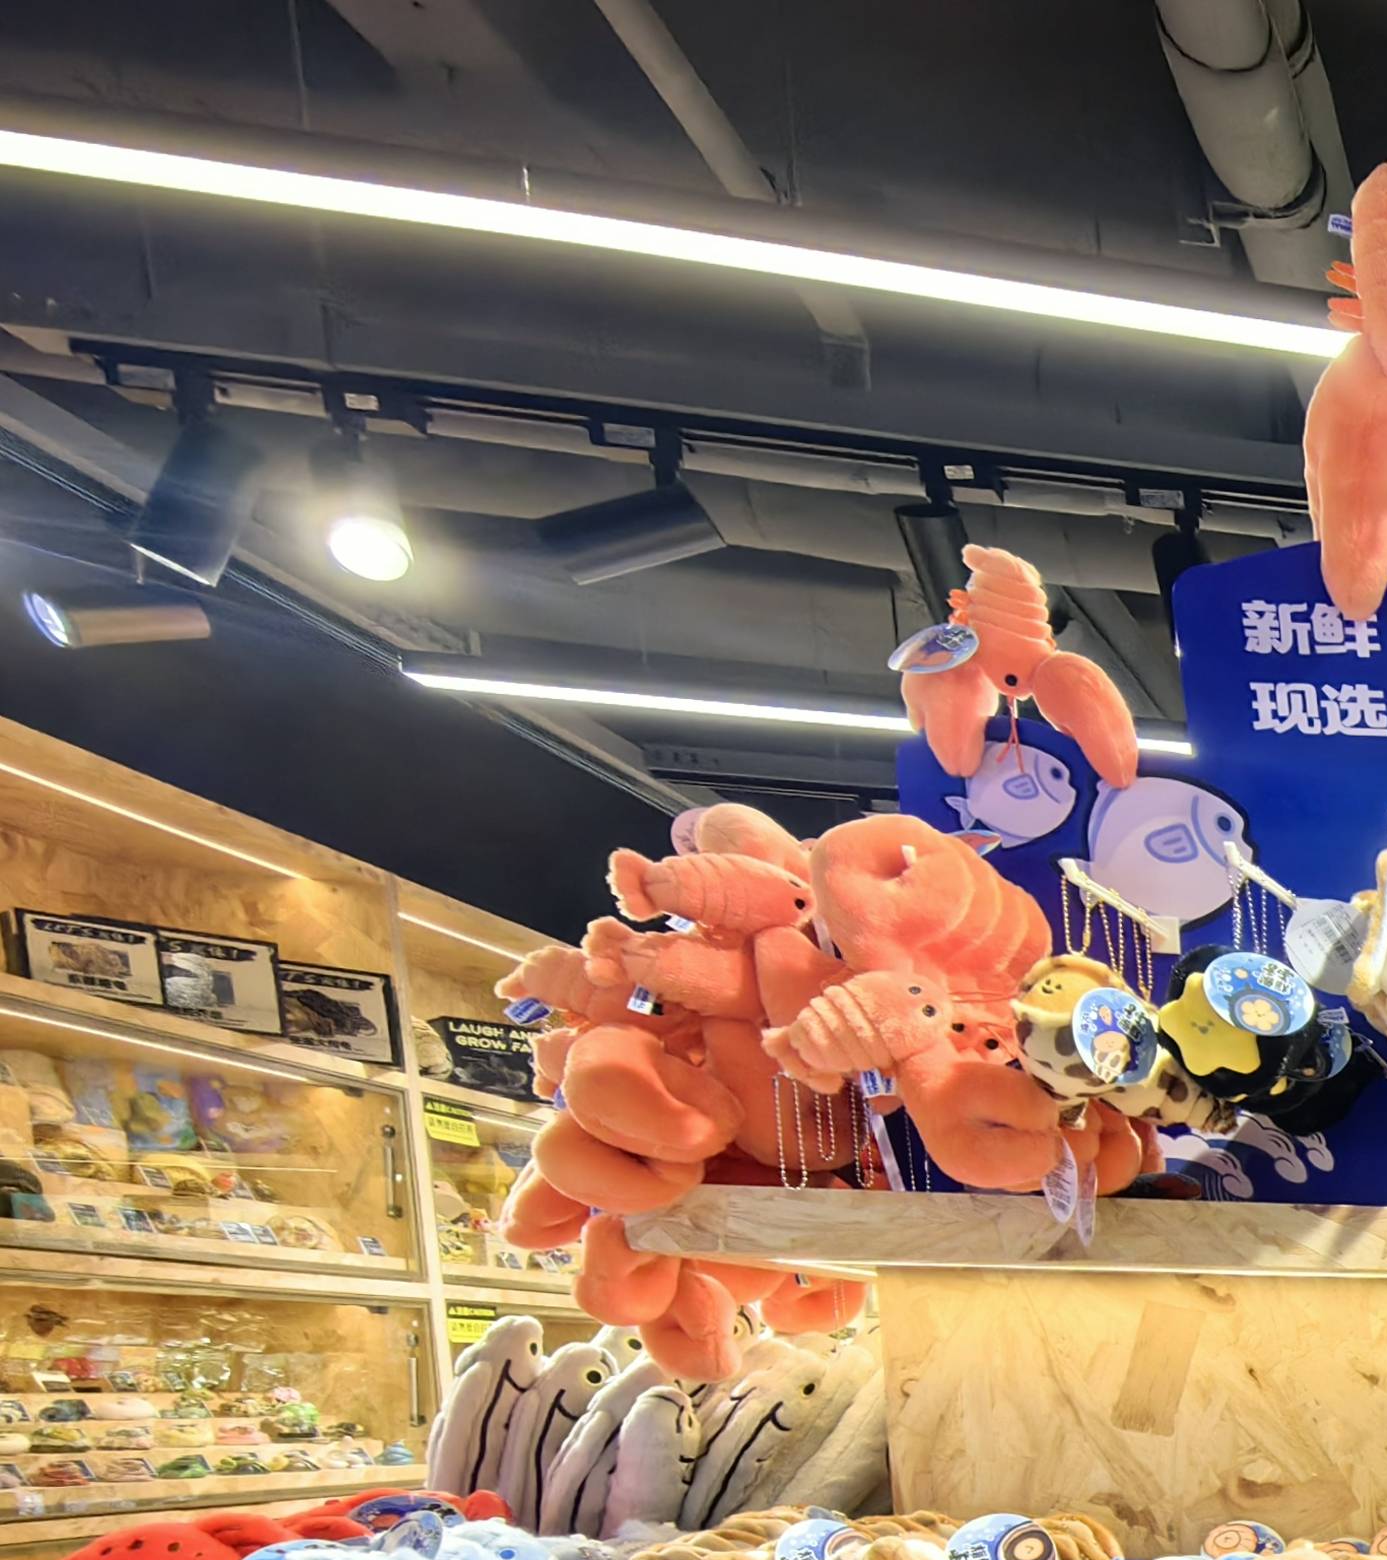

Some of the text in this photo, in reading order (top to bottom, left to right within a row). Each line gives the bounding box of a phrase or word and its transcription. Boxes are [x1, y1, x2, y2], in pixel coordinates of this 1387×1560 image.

[1241, 599, 1382, 658] 新鲜
[448, 1020, 504, 1038] LAUGH
[455, 1034, 507, 1051] GROW
